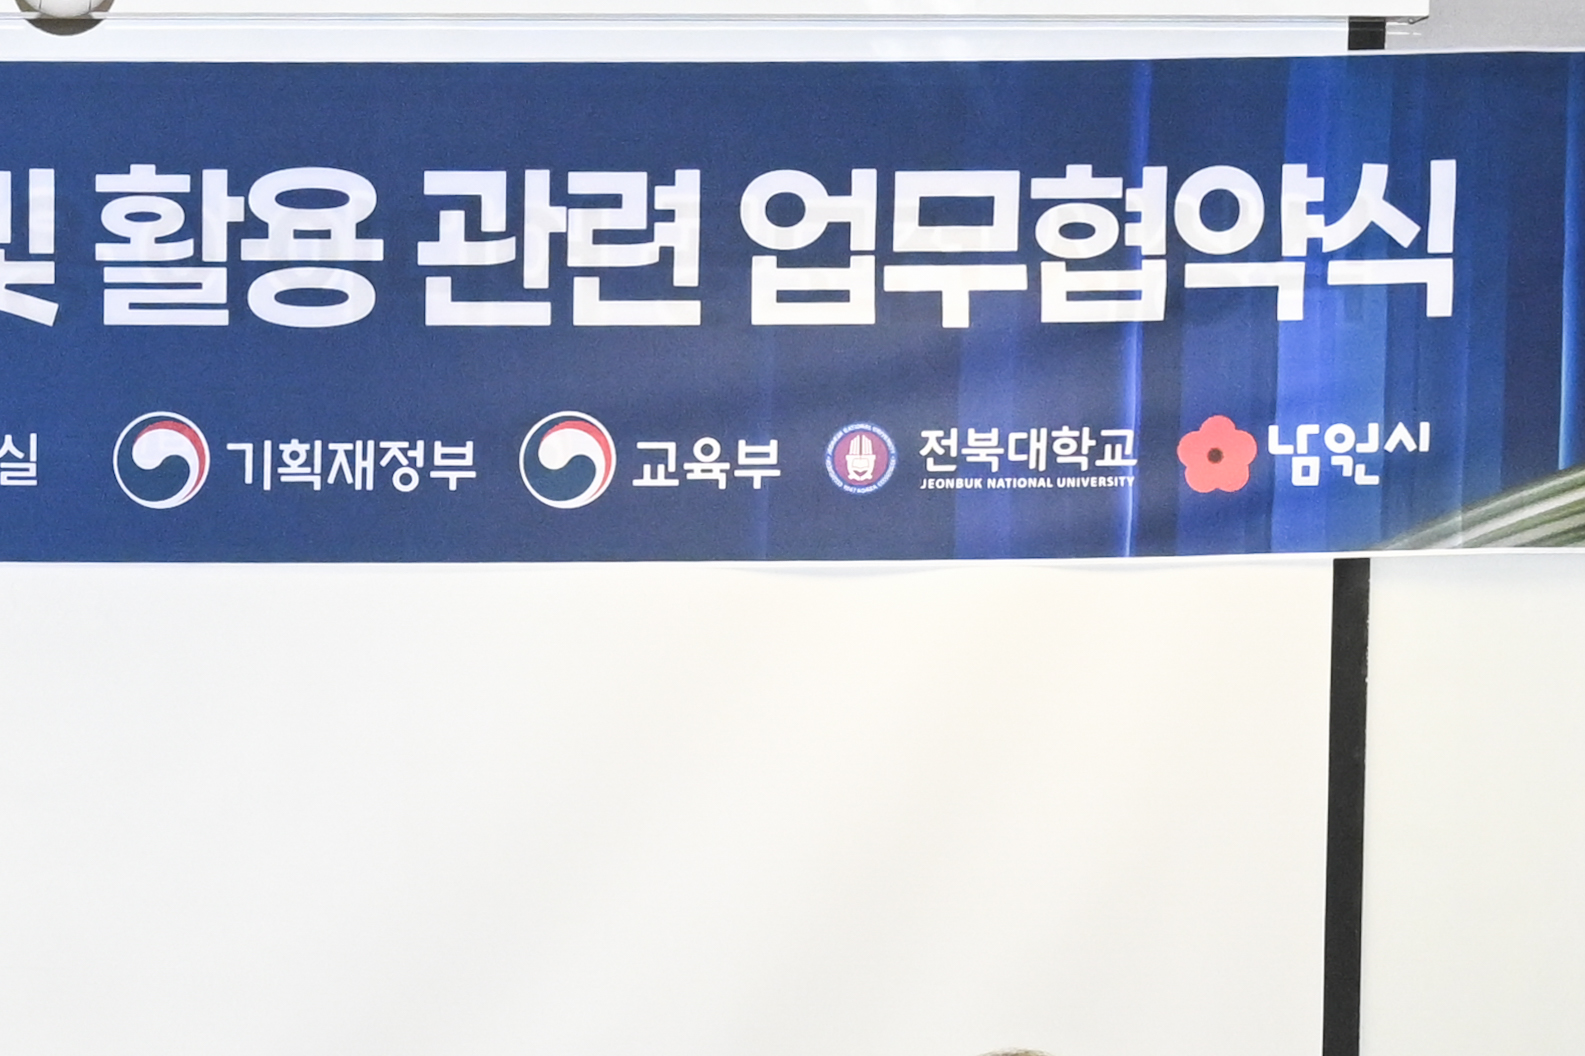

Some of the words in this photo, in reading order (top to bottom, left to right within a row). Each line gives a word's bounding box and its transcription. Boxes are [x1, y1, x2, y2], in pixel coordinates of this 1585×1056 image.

[95, 164, 384, 328] 활용
[416, 169, 702, 326] 관련
[740, 159, 1457, 328] 업무협약식
[226, 438, 477, 492] 기획재정부
[632, 436, 781, 490] 교육부
[919, 425, 1138, 472] 전북대학교
[1267, 421, 1430, 486] 남원시
[919, 477, 983, 490] JEONBUK
[986, 477, 1054, 489] NATIONAL
[1056, 476, 1135, 488] UNIVERSITY
